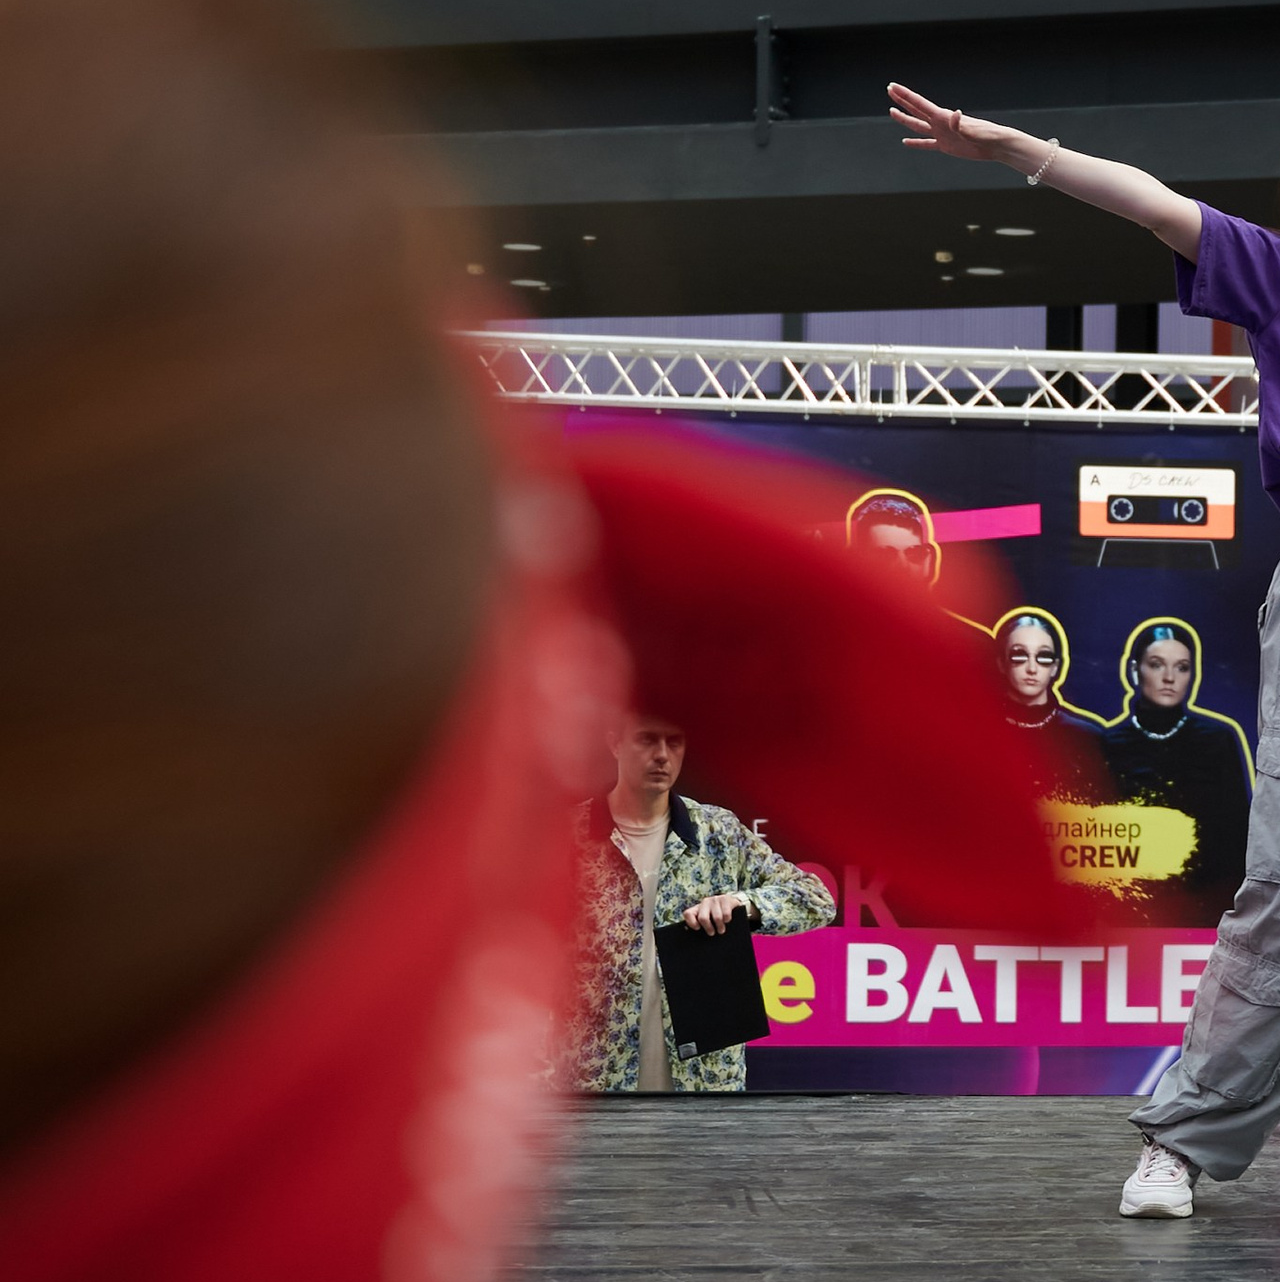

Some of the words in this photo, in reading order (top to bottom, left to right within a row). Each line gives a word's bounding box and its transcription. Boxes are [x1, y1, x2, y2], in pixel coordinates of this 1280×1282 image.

[1090, 474, 1101, 486] A
[1059, 845, 1141, 868] CREW
[846, 942, 1214, 1023] BATTLE
